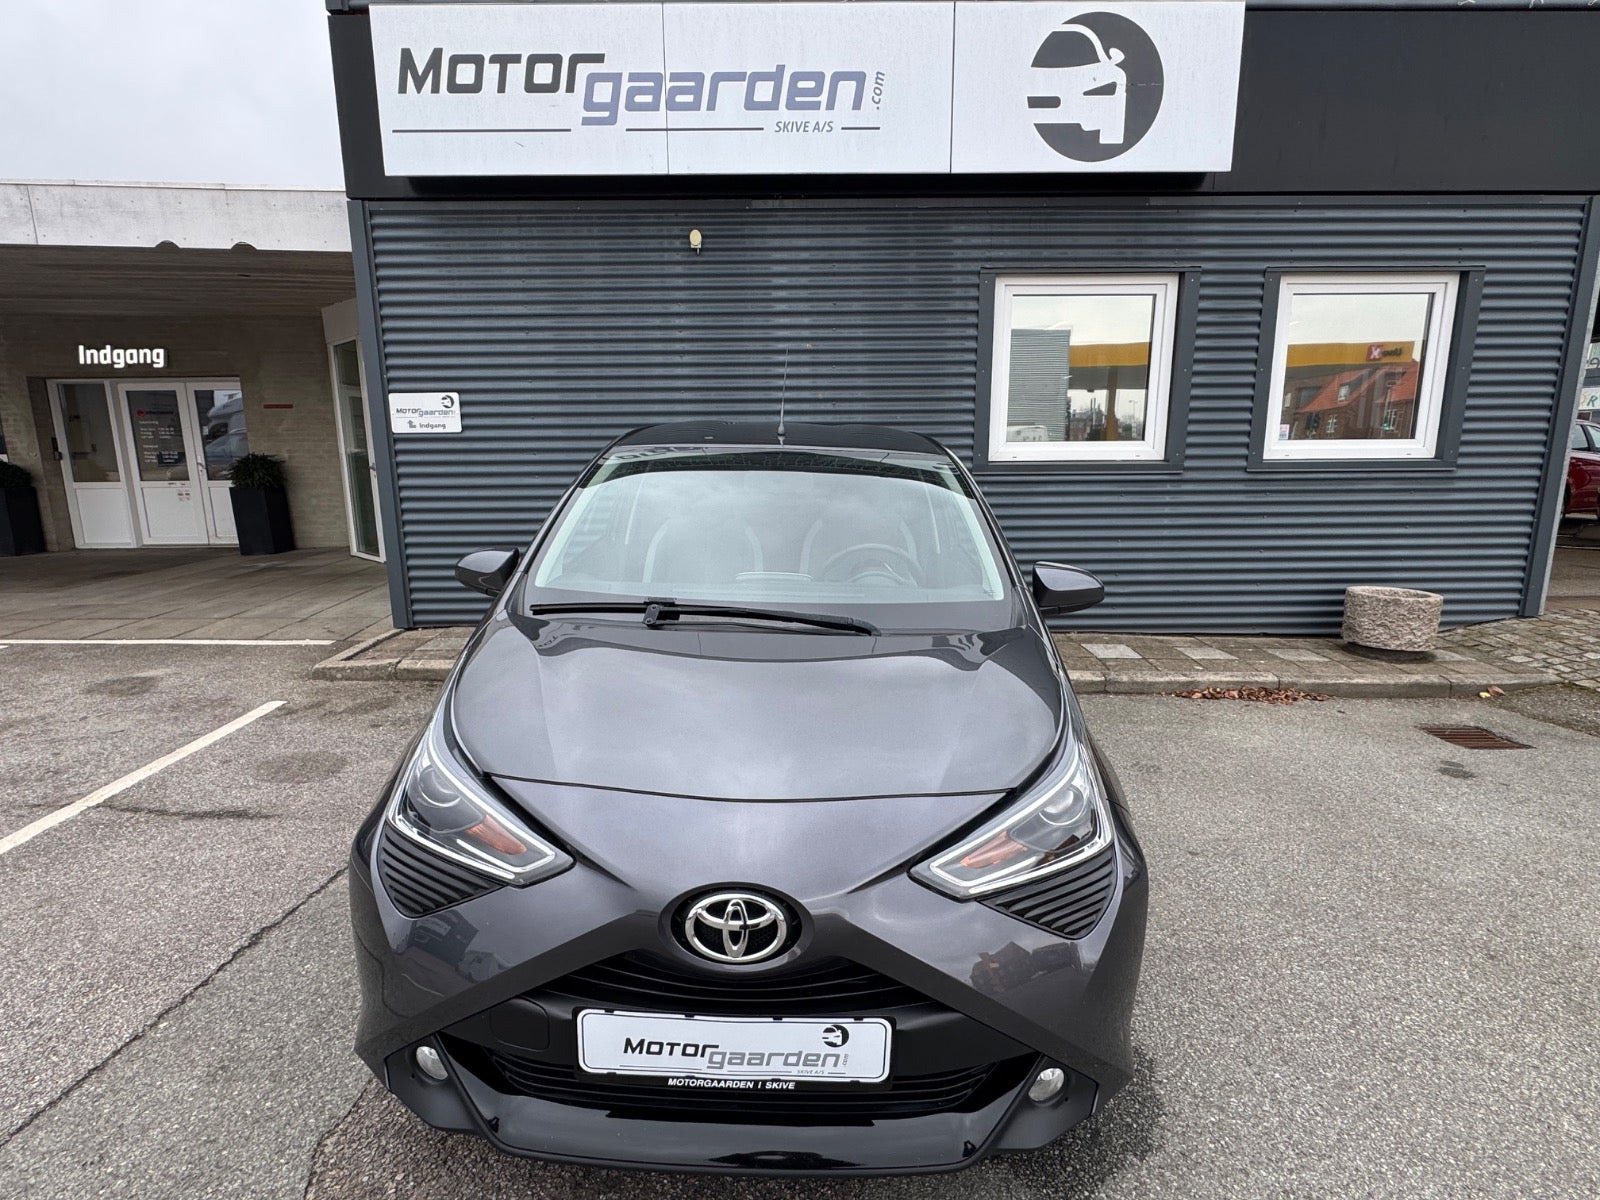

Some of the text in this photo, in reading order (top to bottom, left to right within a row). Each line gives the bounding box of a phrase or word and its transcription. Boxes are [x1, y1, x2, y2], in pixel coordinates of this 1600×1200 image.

[774, 120, 834, 133] SKIVE A/S
[78, 344, 165, 369] Indgang
[419, 422, 447, 430] Indgang
[667, 1078, 755, 1089] MOTORGAARDEN
[765, 1081, 796, 1090] SKIVE
